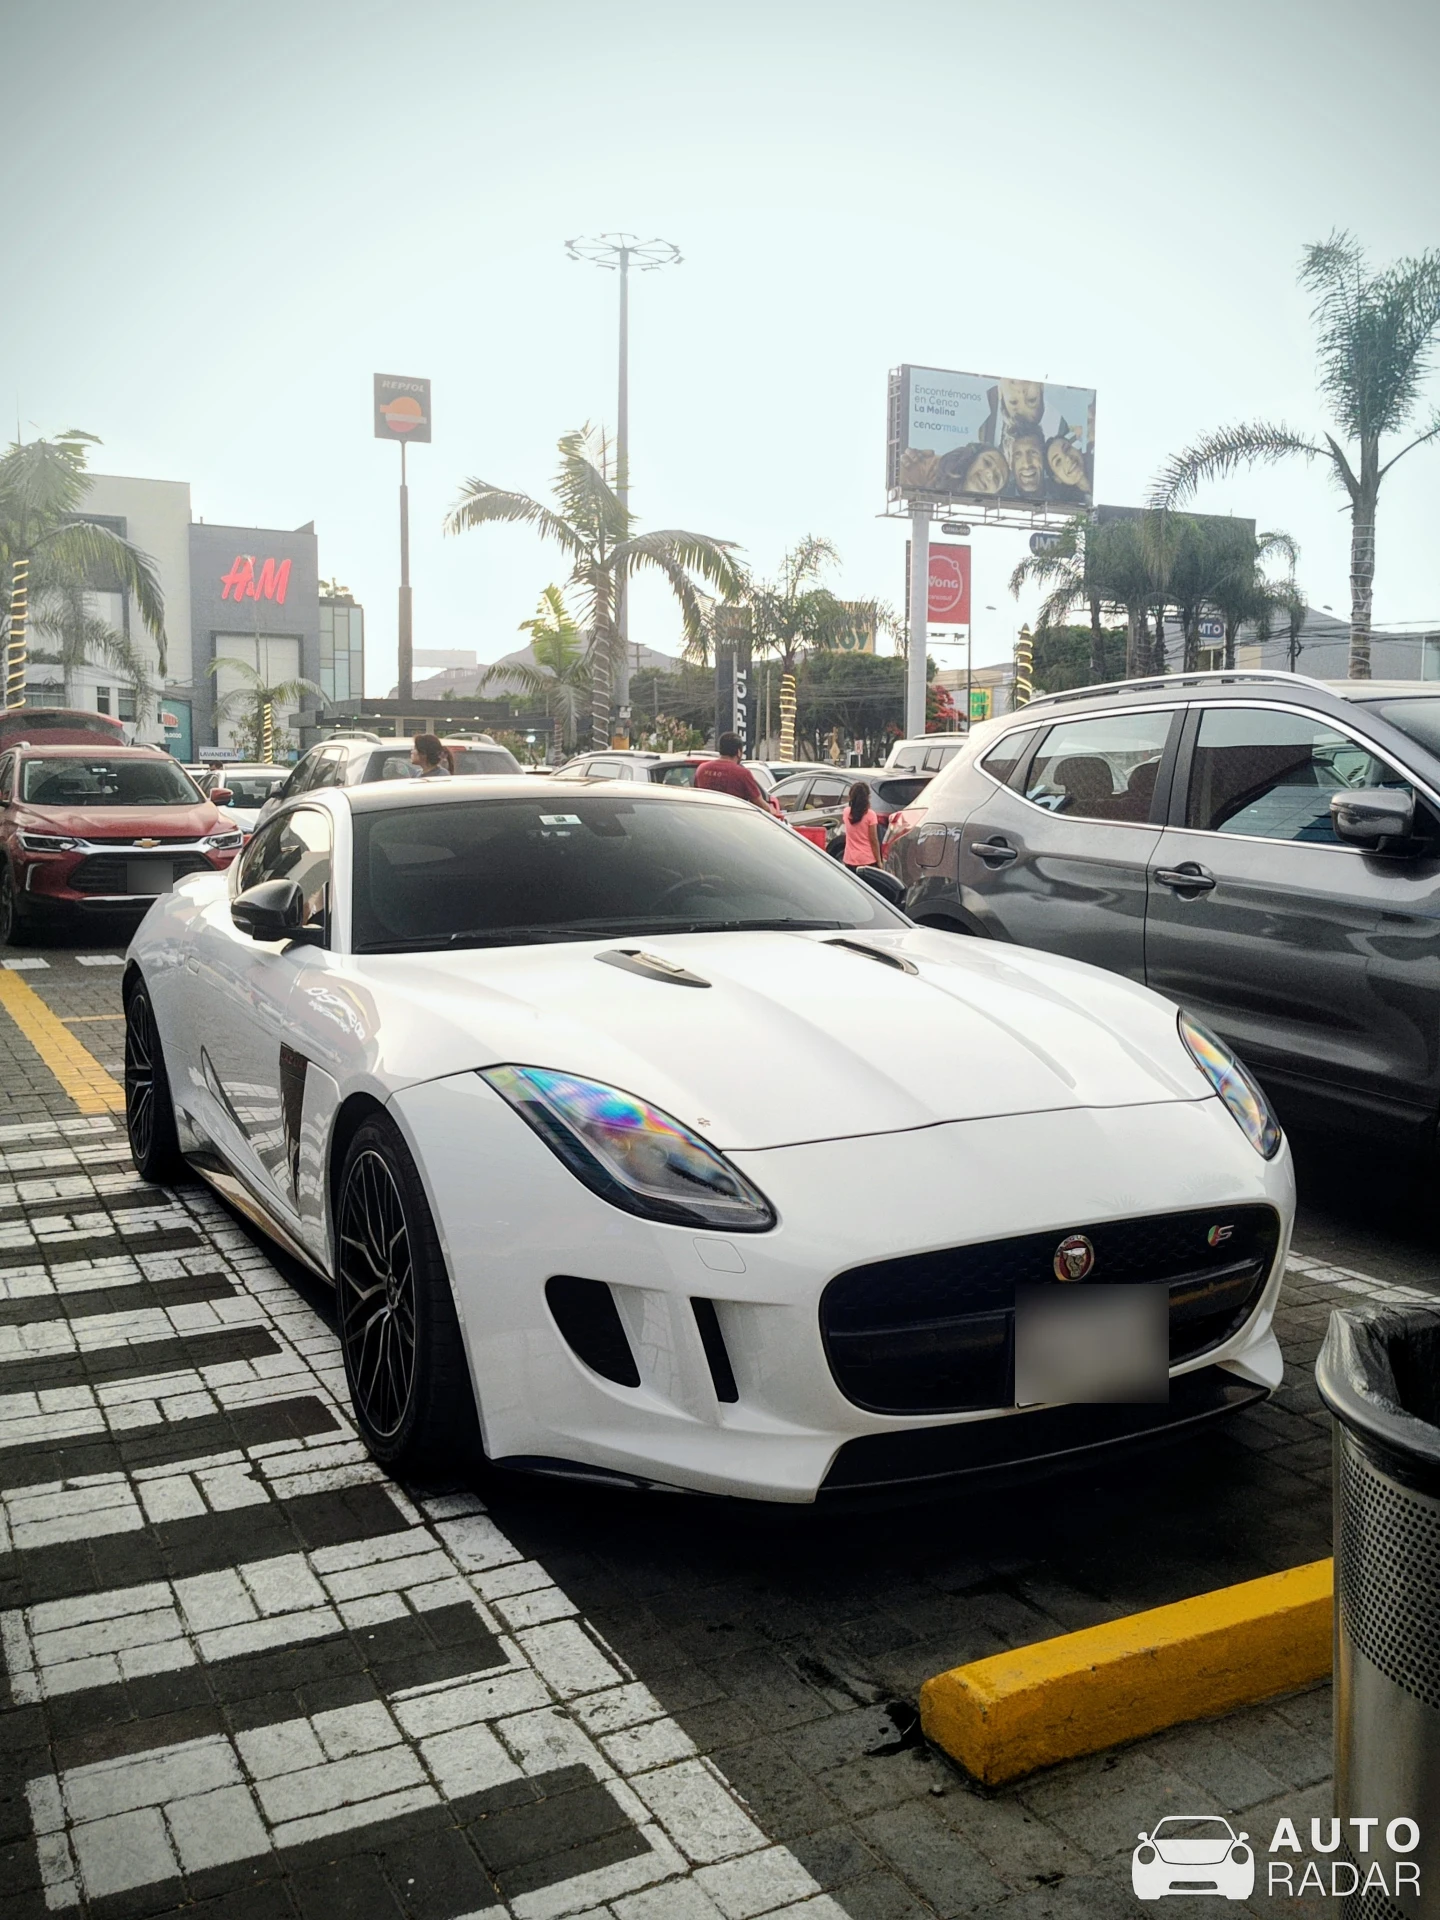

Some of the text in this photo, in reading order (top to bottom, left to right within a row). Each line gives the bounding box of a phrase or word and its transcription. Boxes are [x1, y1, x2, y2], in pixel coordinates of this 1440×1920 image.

[381, 380, 425, 393] REPSOL
[914, 384, 982, 402] Encontrémonos
[914, 395, 960, 408] en Cenco
[914, 403, 956, 417] La Molina
[220, 555, 292, 605] H&M
